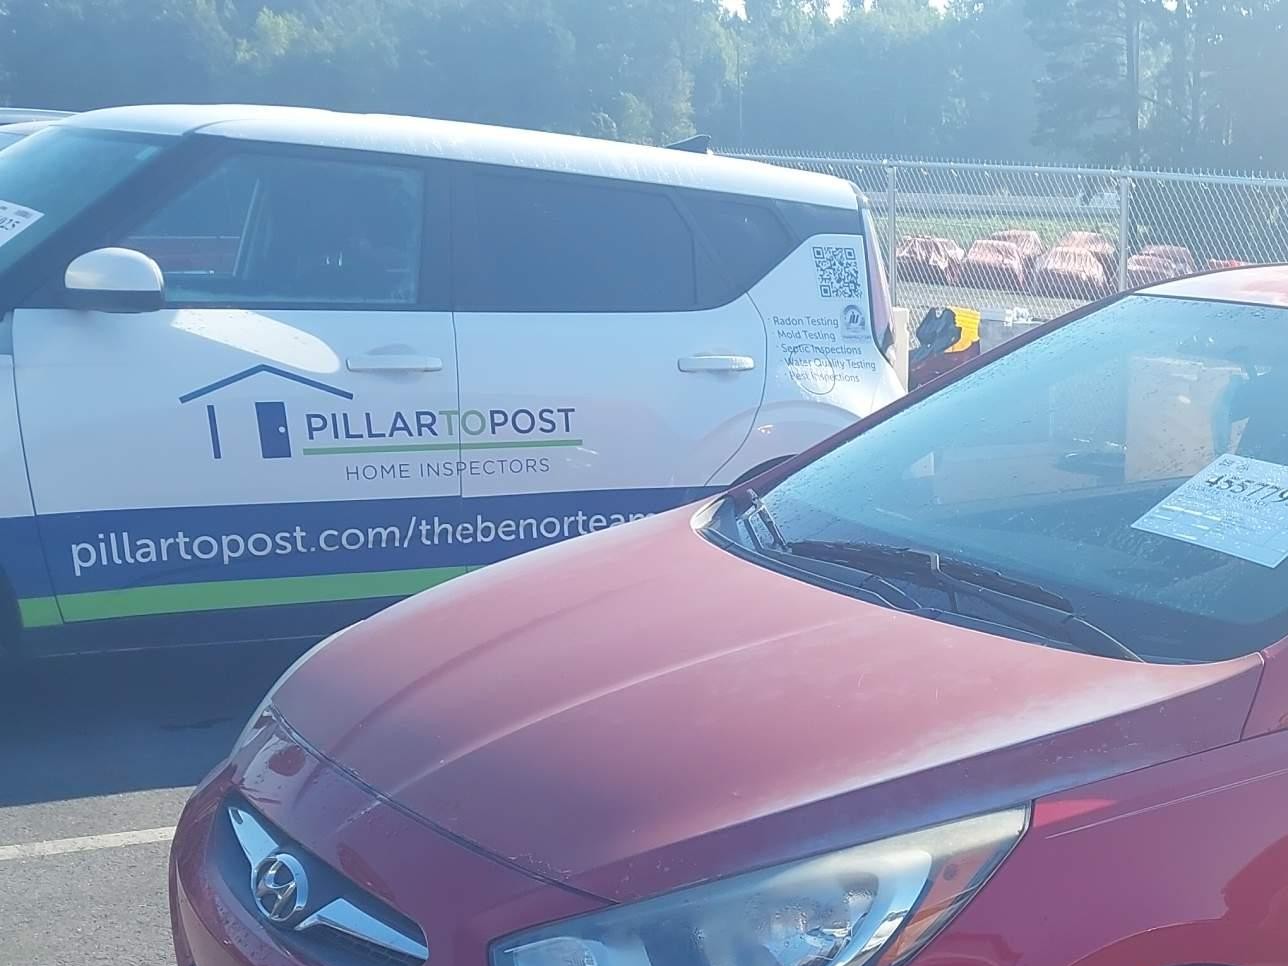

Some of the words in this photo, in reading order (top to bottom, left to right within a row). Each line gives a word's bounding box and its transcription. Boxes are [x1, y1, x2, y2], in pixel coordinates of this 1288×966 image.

[773, 316, 804, 326] Radon
[805, 317, 839, 328] Testing
[777, 330, 802, 339] Mold
[803, 330, 836, 342] Testing
[781, 344, 811, 355] Septic
[811, 345, 862, 356] Inspections
[784, 357, 812, 367] Water
[813, 358, 845, 369] Quality
[846, 360, 876, 372] Testing
[305, 408, 576, 440] PILLARTOPOST
[346, 463, 411, 481] HOME
[420, 458, 550, 478] INSPECTORS
